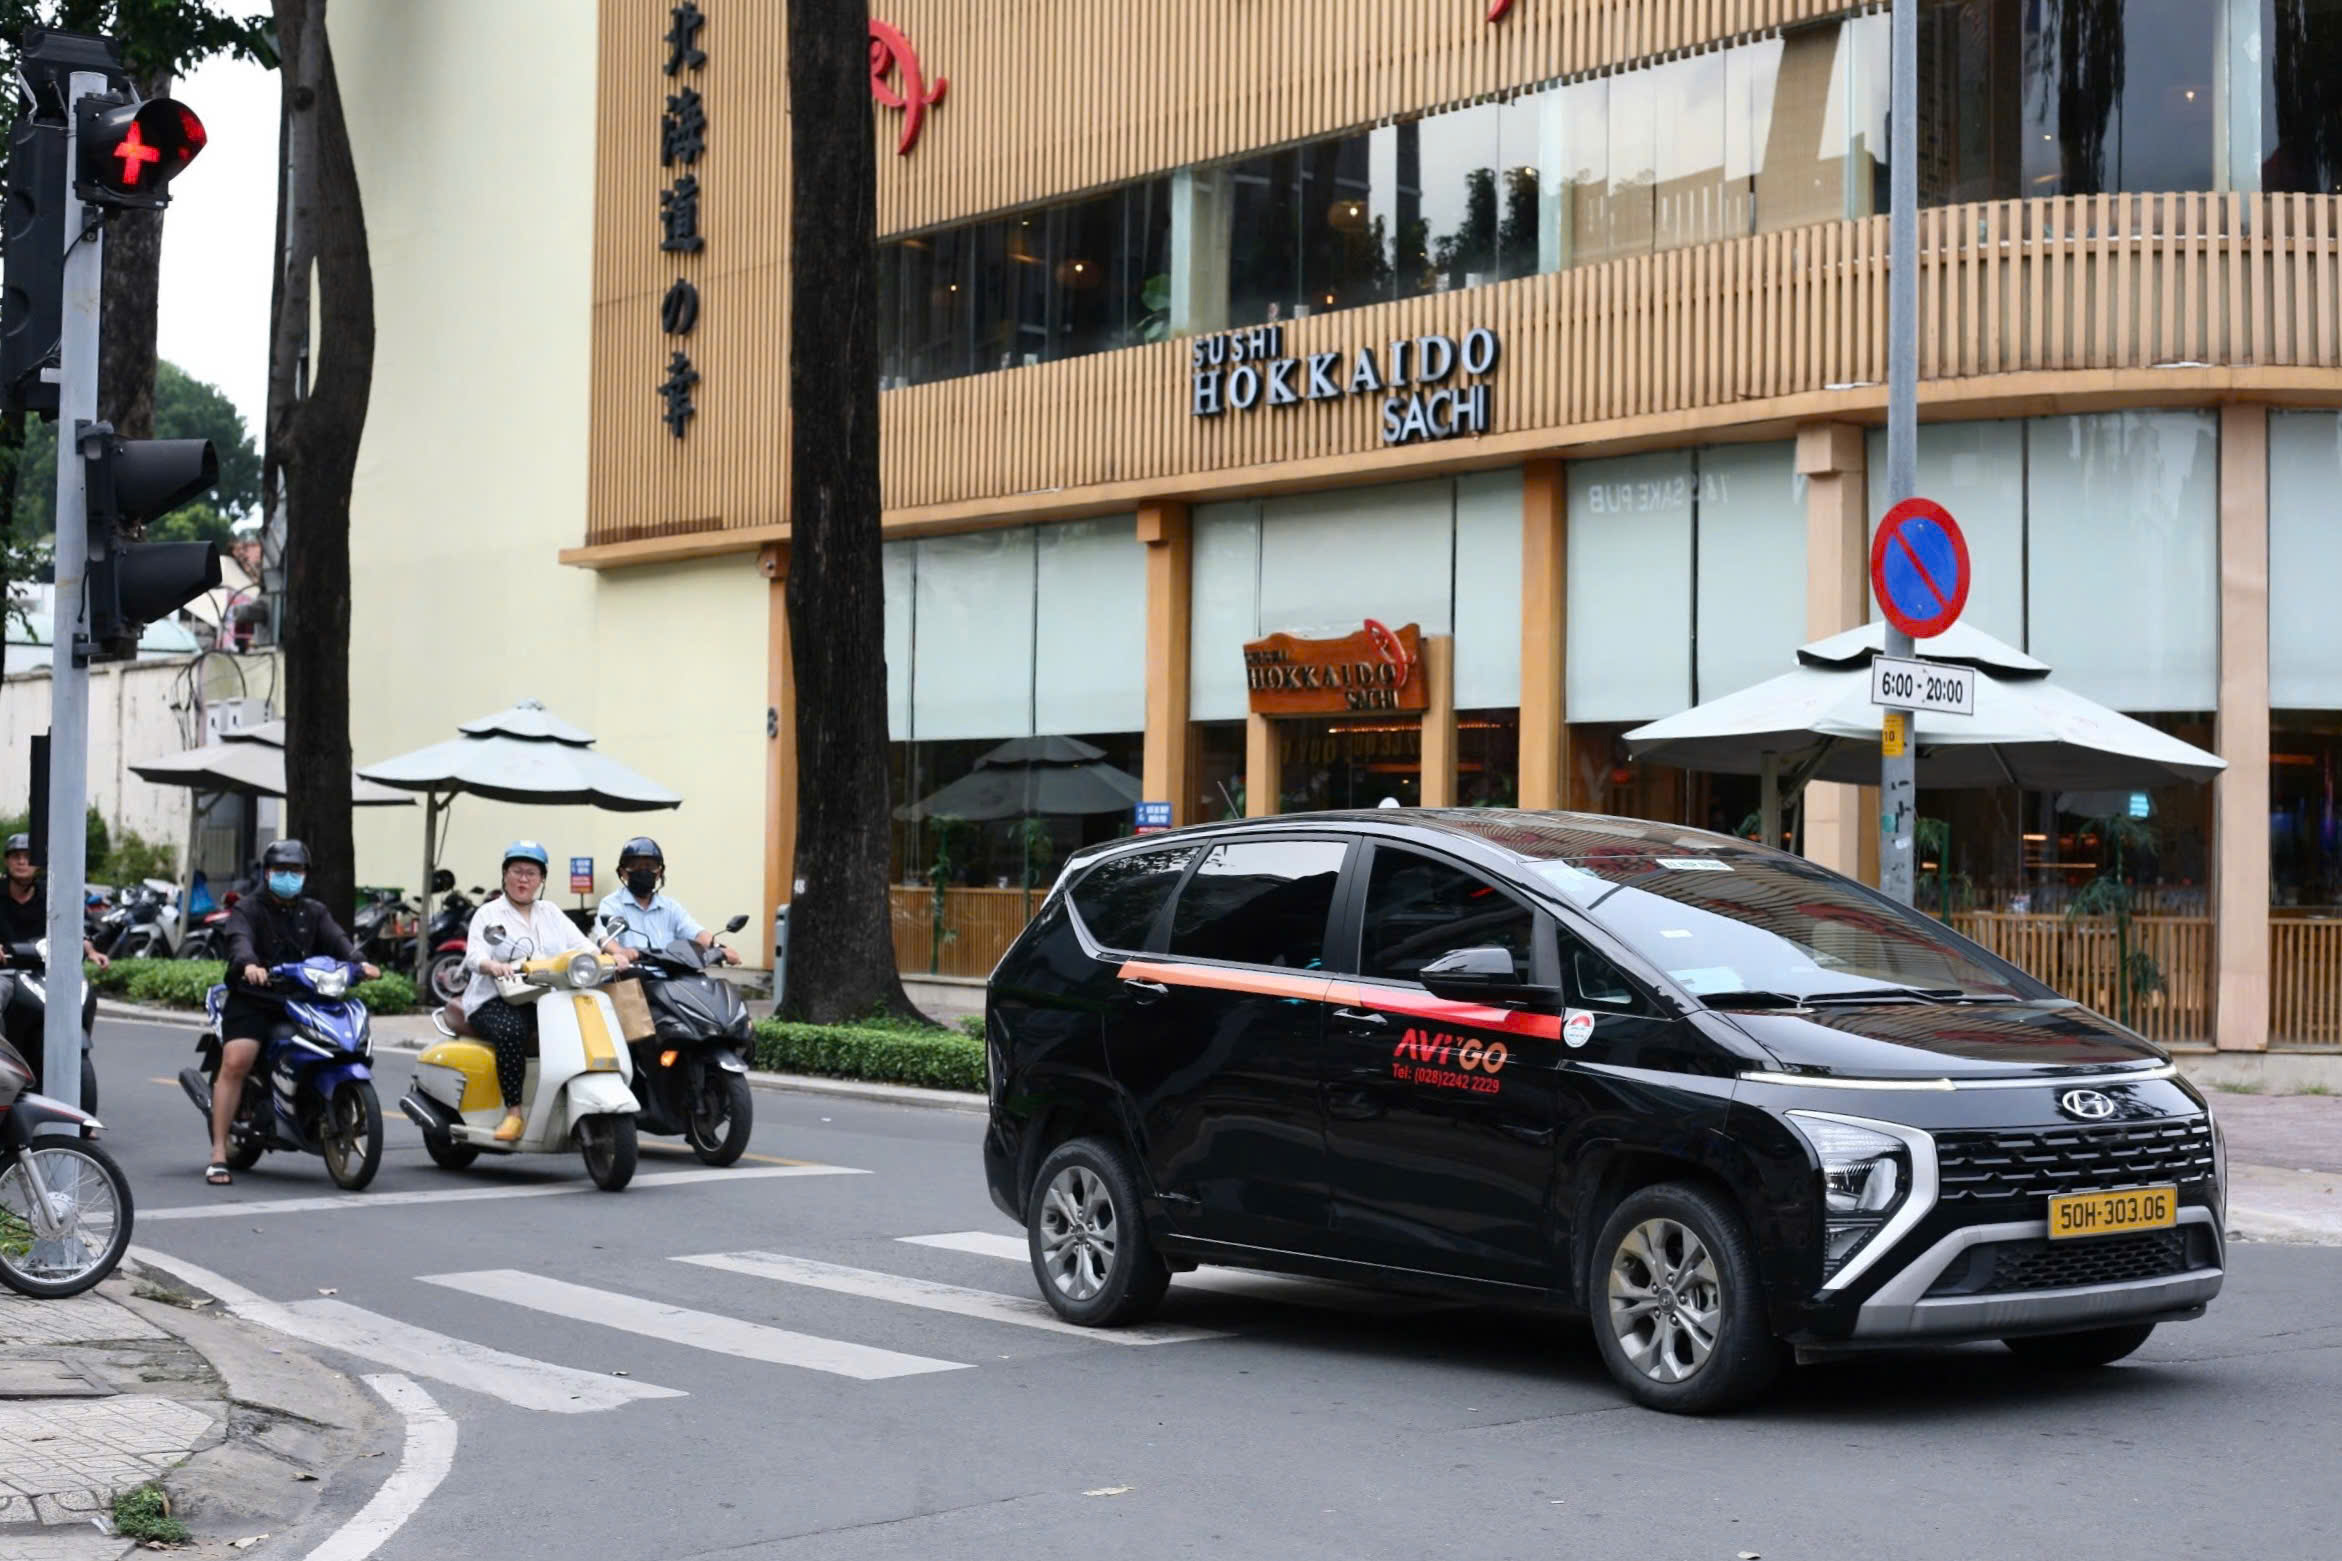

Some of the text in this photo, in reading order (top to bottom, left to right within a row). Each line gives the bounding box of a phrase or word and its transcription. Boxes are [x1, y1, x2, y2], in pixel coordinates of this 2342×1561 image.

[658, 0, 707, 439] 北海道の幸
[1192, 326, 1283, 369] SUSHI
[1192, 327, 1500, 419] HOKKAIDO
[1382, 384, 1492, 446] SACHI
[1248, 661, 1399, 690] HOKKAIDO
[1882, 671, 1914, 699] 6:00
[1926, 676, 1964, 705] 20:00
[1393, 1062, 1501, 1094] Tel: (028)2242 2229
[2060, 1194, 2167, 1230] 50H-303.06
